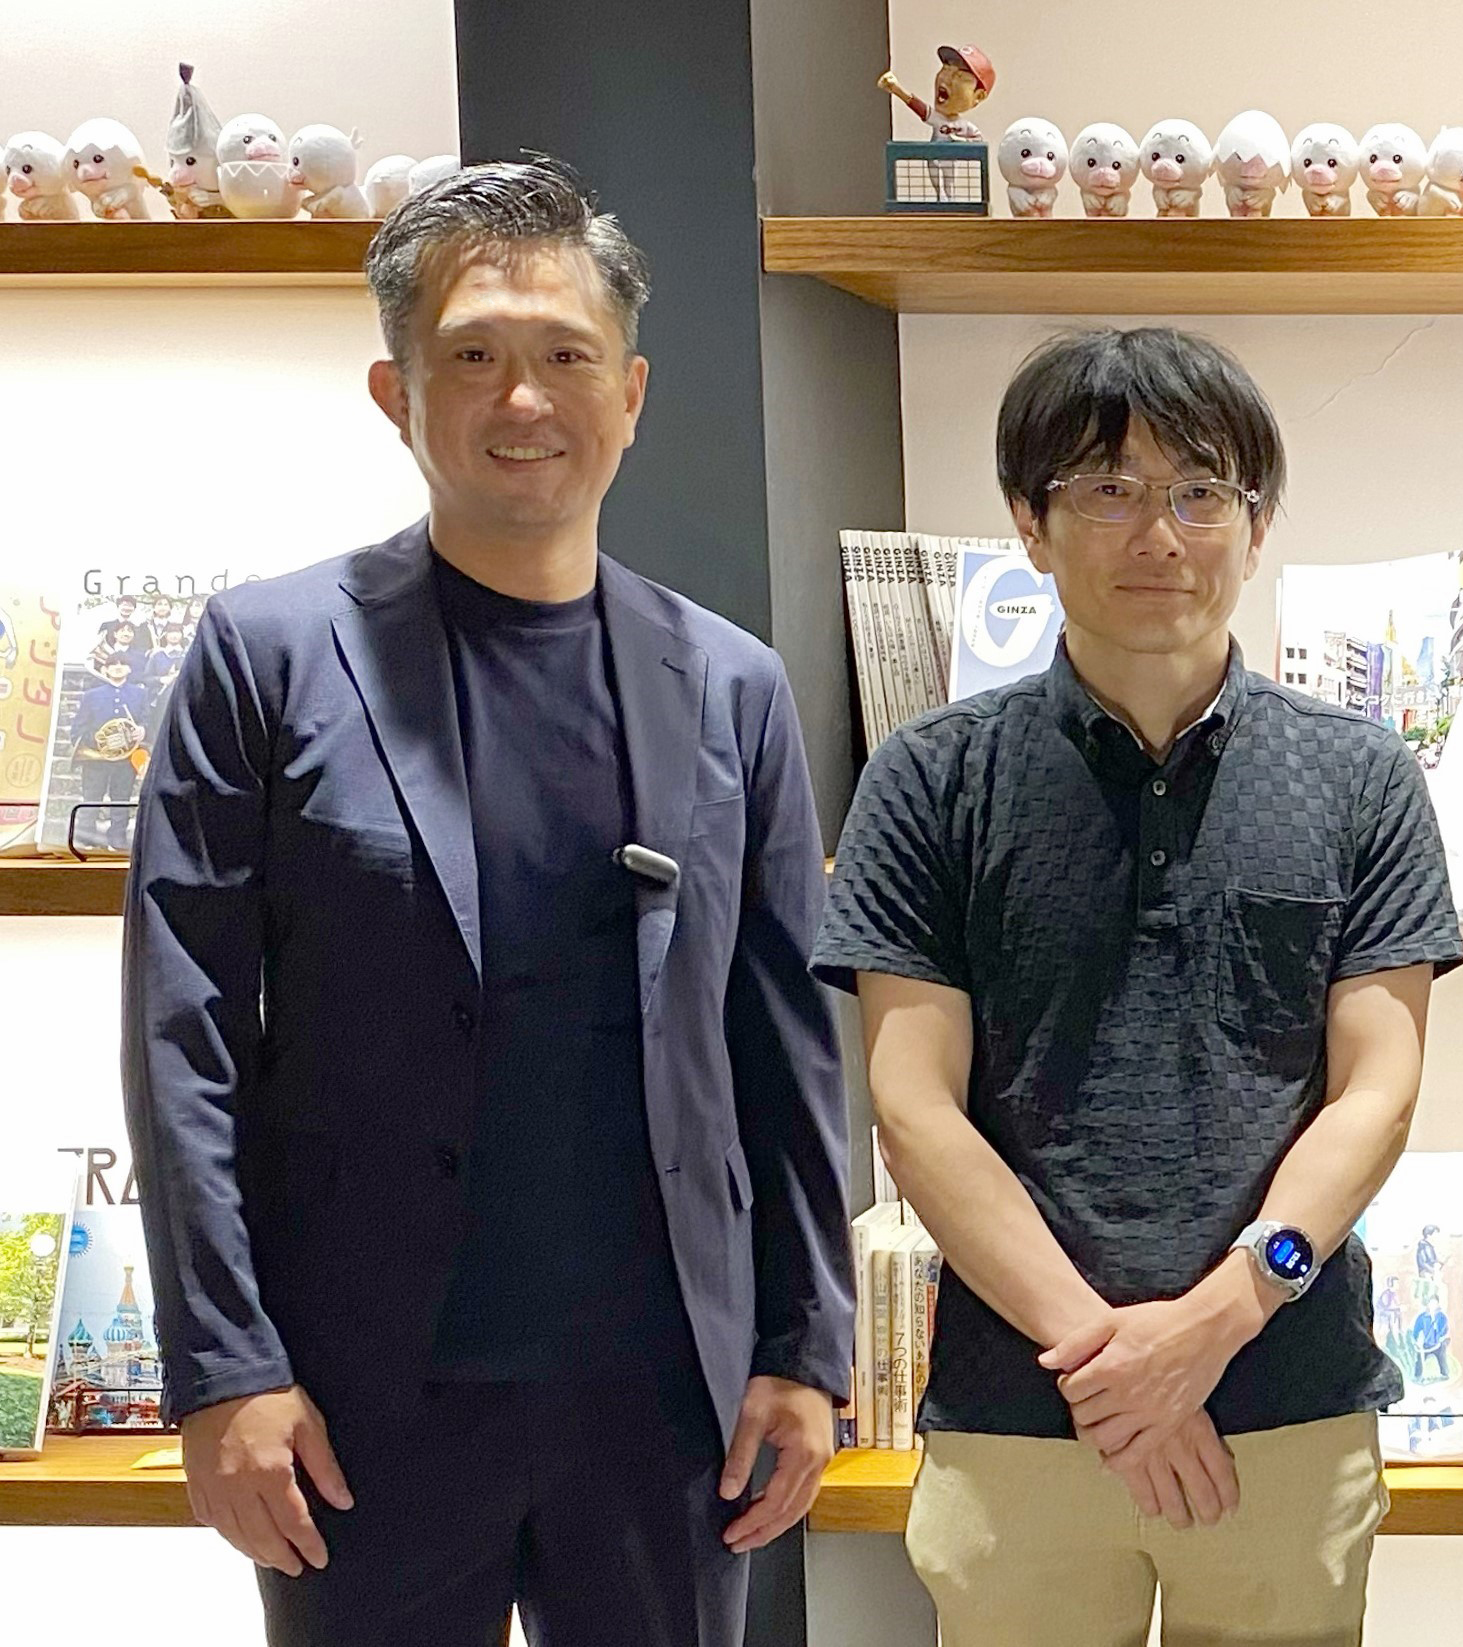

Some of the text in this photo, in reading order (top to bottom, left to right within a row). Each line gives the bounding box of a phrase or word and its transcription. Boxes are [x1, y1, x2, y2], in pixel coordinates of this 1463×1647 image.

[863, 546, 875, 582] GINZA
[873, 547, 885, 583] GINZA
[883, 547, 895, 583] GINZA
[893, 547, 905, 583] GINZA
[903, 547, 916, 584] GINZA
[913, 547, 925, 584] GINZA
[920, 549, 933, 586] GINZA
[933, 551, 946, 587] GINZA
[997, 605, 1036, 614] GINZA
